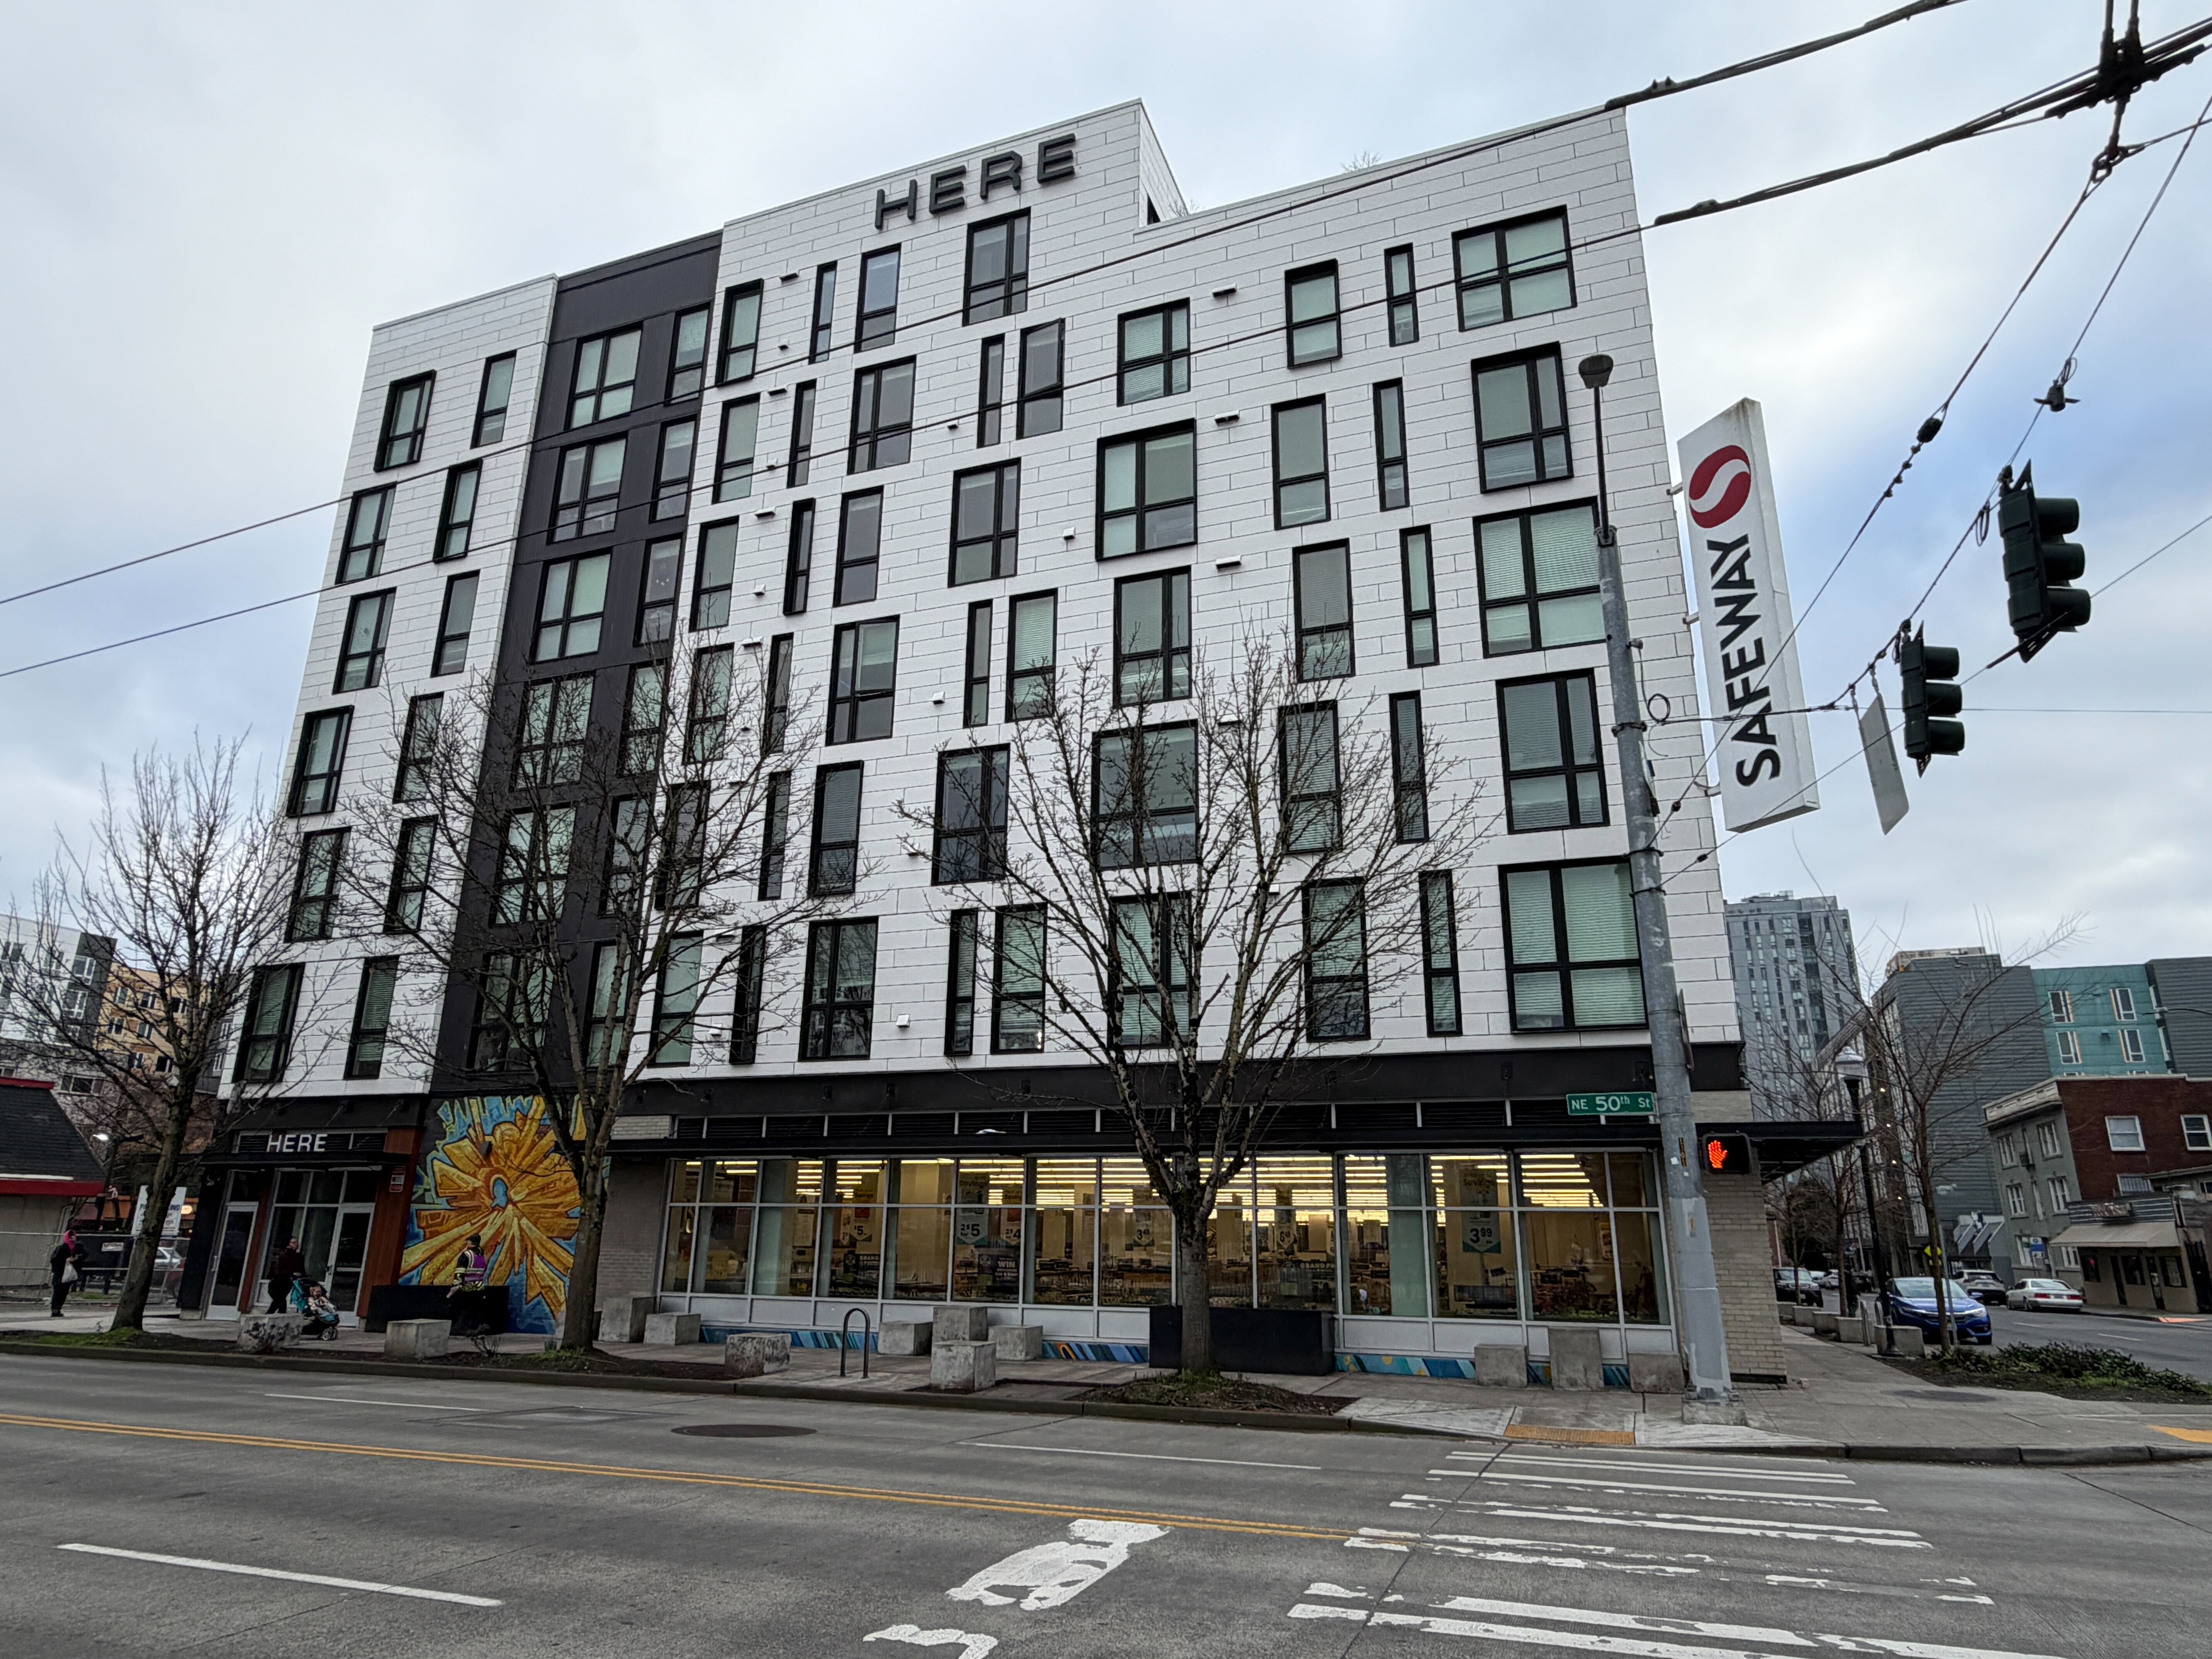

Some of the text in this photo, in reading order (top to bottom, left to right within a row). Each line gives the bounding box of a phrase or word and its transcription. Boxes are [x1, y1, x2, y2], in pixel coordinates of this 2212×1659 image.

[874, 133, 1076, 229] HERE
[1706, 533, 1781, 787] SAFEWAY
[1571, 1095, 1651, 1111] NE 50th St
[266, 1133, 328, 1152] HERE
[998, 1260, 1016, 1268] WIN
